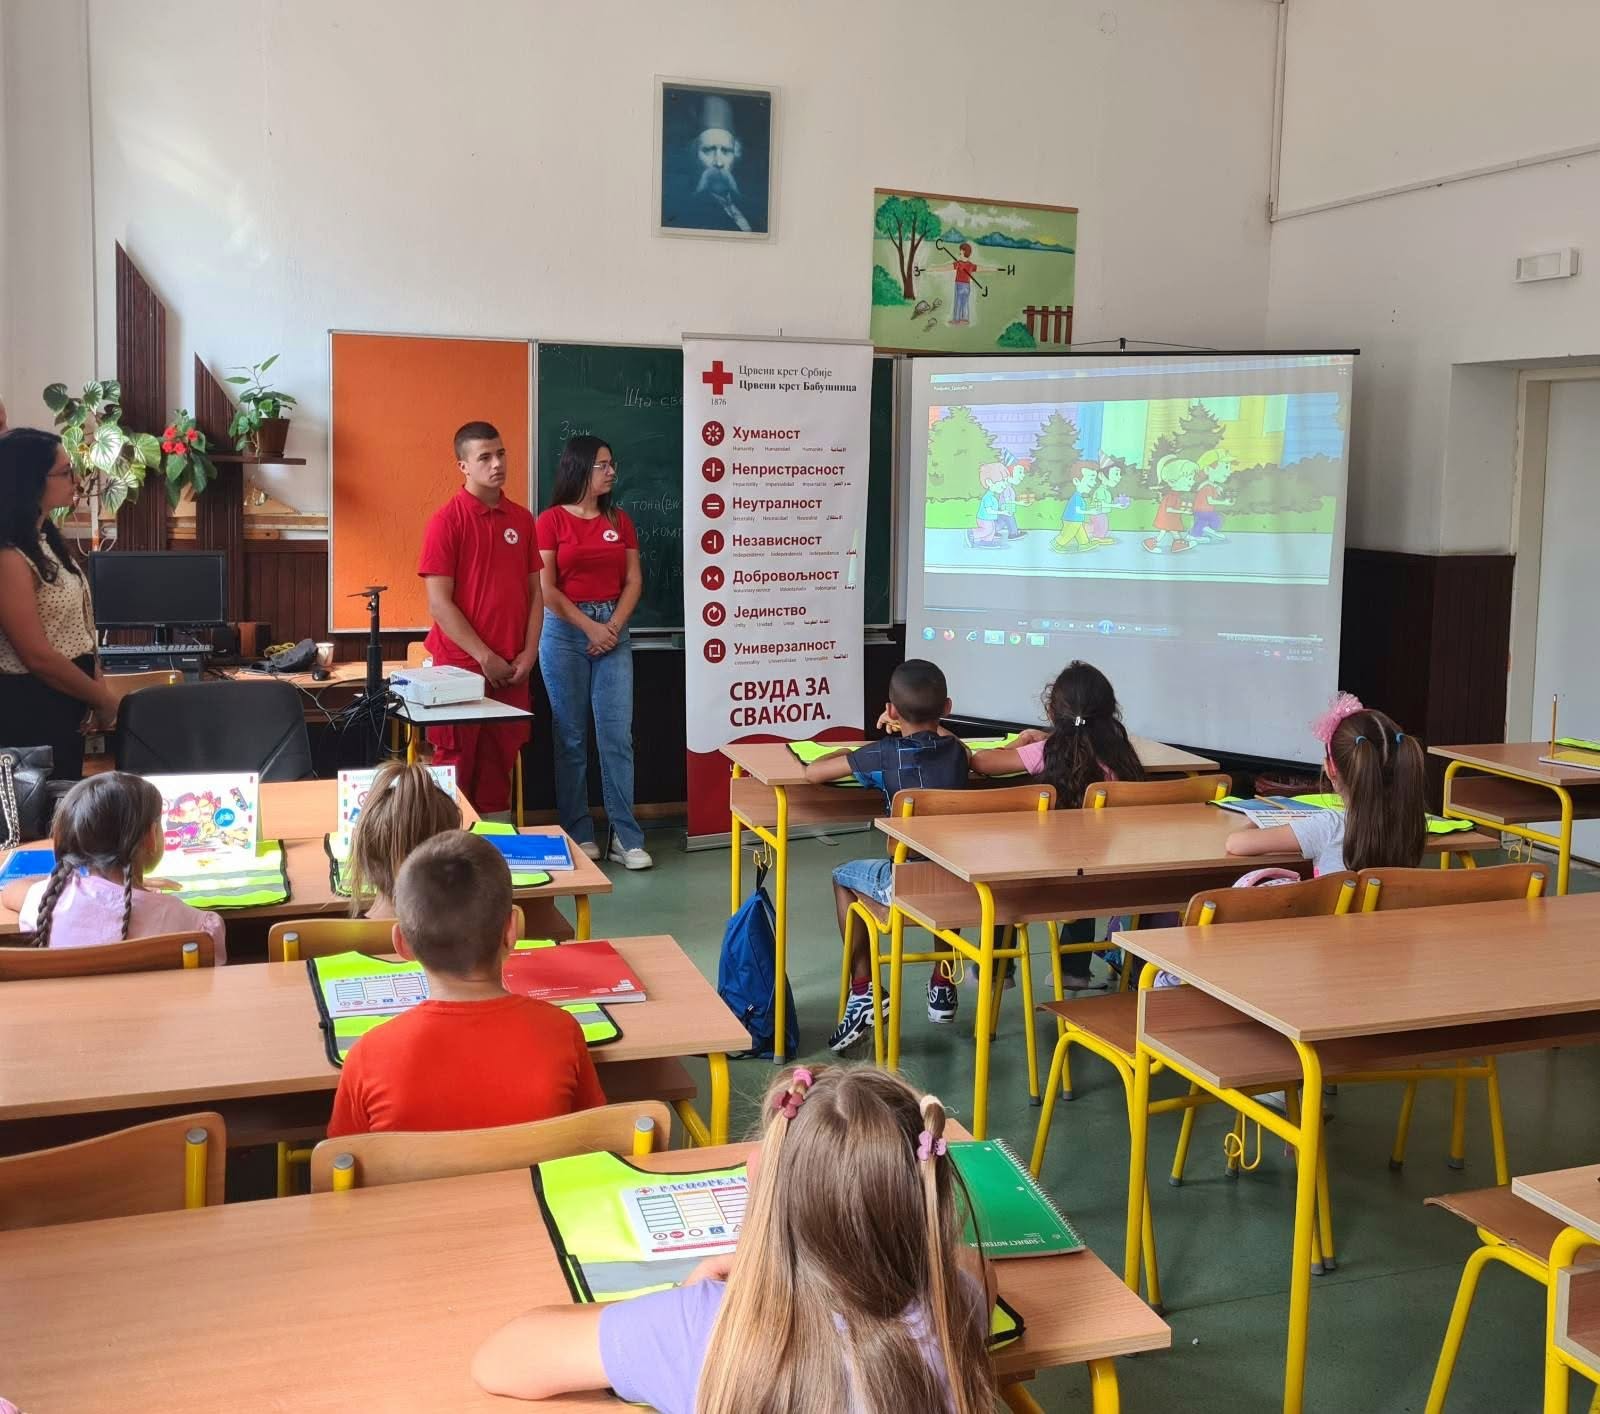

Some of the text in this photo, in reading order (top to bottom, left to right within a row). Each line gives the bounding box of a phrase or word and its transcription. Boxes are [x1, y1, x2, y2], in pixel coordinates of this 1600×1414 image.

[739, 365, 833, 378] Црвени крст Србије
[739, 380, 857, 394] Црвени крст Бабушница
[711, 398, 727, 406] 1876
[732, 426, 800, 441] Хуманост
[732, 463, 845, 478] Непристрасност
[732, 497, 822, 512] Неутралност
[732, 535, 822, 547] Независност
[733, 570, 840, 584] Добровољност
[733, 606, 807, 619] Јединство
[733, 640, 837, 655] Универзалност
[730, 677, 831, 703] СВУДА ЗА
[730, 702, 831, 727] СВАКОГА.
